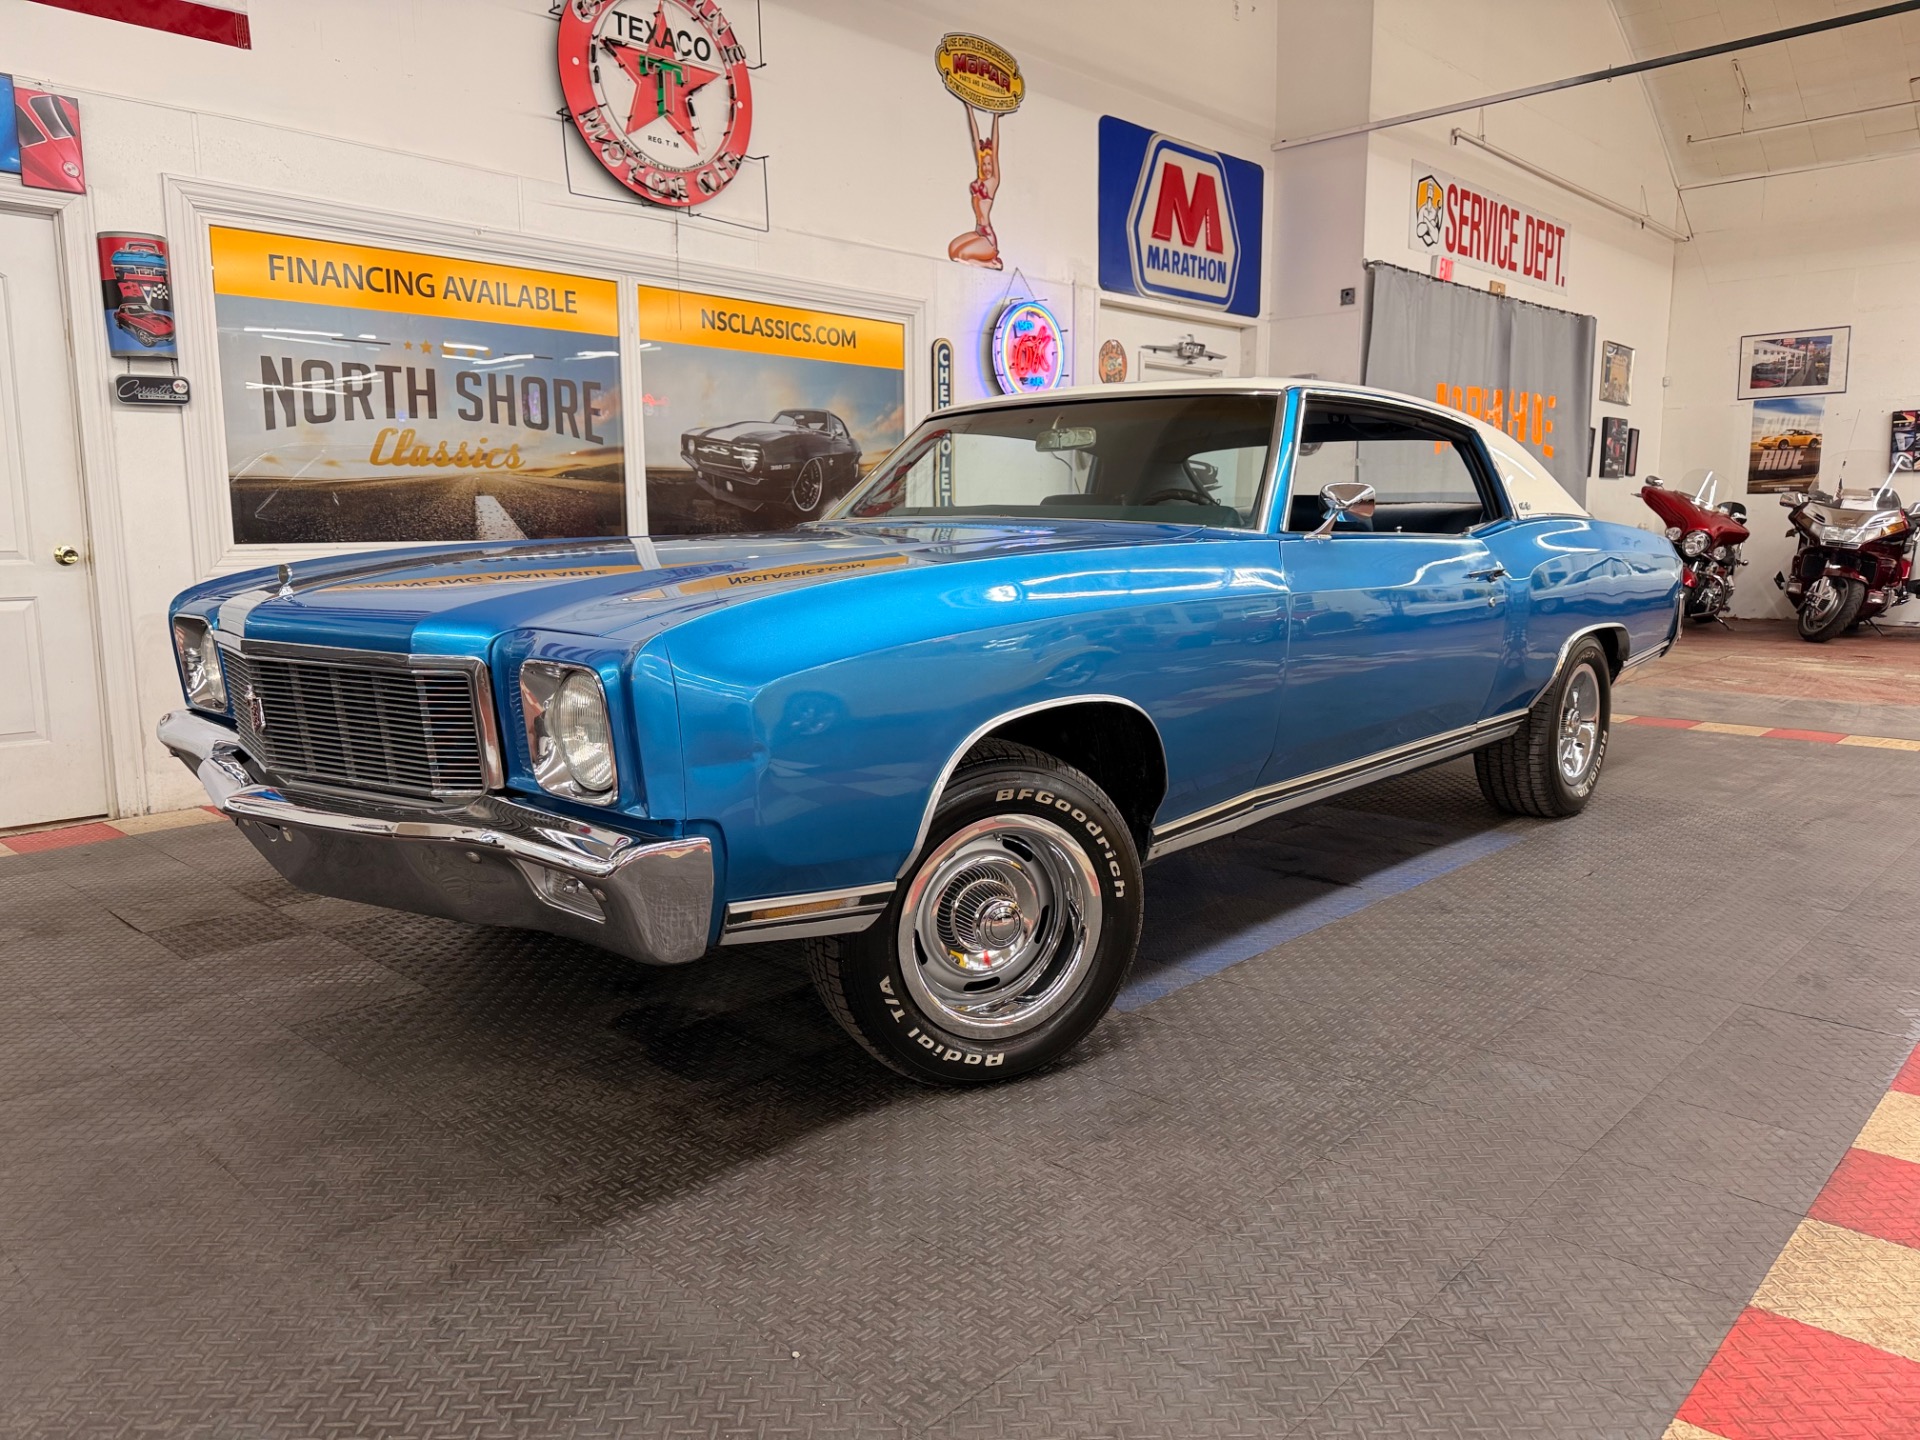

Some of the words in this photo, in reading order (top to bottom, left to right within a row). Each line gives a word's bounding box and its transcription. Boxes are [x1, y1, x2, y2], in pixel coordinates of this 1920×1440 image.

[612, 11, 711, 61] TEXACO
[578, 106, 690, 203] MOTOR
[1152, 162, 1224, 255] M
[1445, 183, 1520, 272] SERVICE
[1523, 214, 1566, 287] DEPT.
[268, 253, 436, 299] FINANCING
[442, 275, 578, 314] AVAILABLE
[1147, 245, 1227, 284] MARATHON
[701, 308, 857, 349] NSCLASSICS.COM
[118, 379, 175, 398] Corvette
[260, 355, 438, 430] NORTH
[456, 371, 604, 446] SHORE
[369, 427, 526, 470] Classics
[938, 349, 952, 508] CHEOLET
[1757, 449, 1805, 471] RIDE
[995, 787, 1126, 898] BFGoodrich
[879, 976, 905, 1023] T/A
[907, 1026, 1005, 1067] Radial
